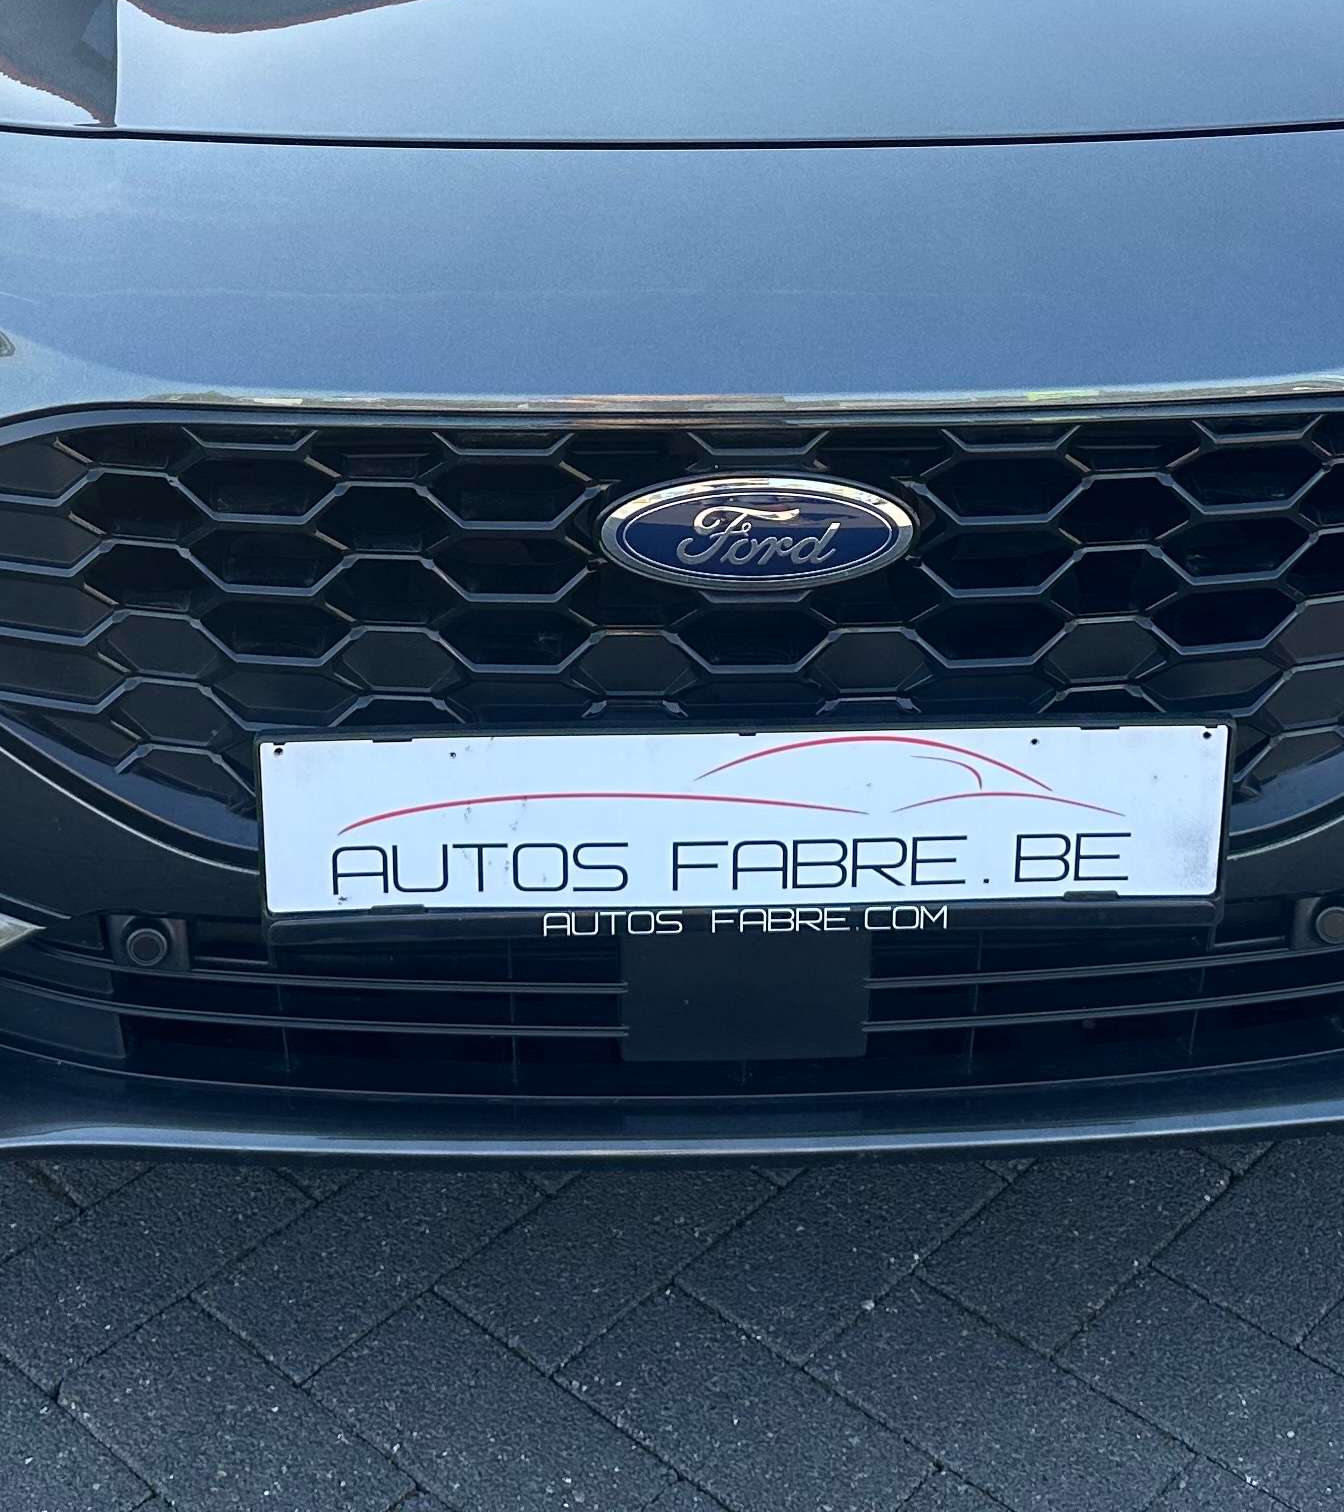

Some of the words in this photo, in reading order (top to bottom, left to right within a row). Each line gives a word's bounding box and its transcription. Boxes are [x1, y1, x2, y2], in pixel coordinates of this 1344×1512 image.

[676, 506, 841, 565] Ford
[331, 842, 629, 895] AUTOS
[543, 909, 684, 937] AUTOS
